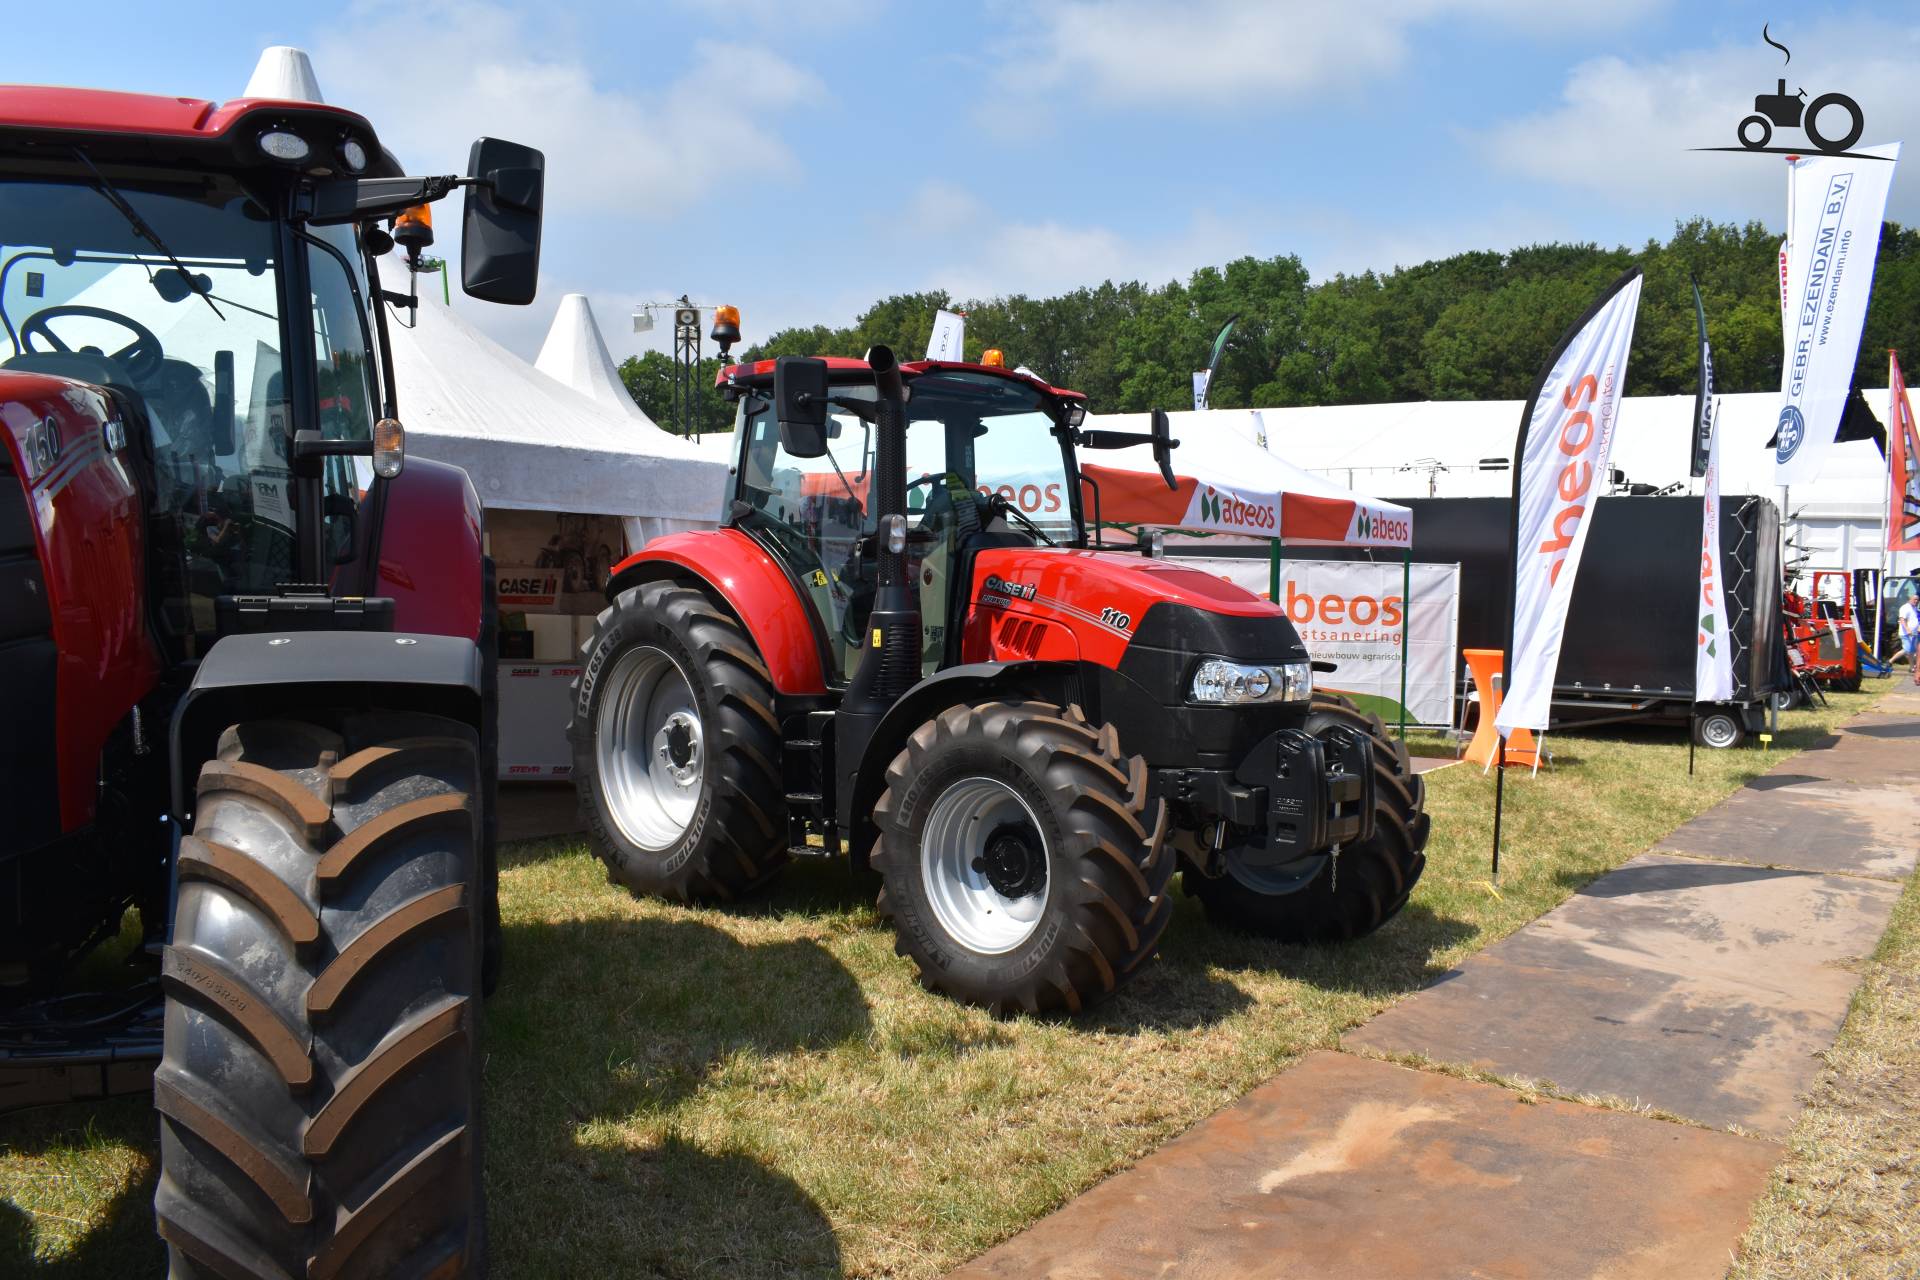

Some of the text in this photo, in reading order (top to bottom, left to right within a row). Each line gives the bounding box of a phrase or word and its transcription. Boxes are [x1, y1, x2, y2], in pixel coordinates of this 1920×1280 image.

[1791, 179, 1848, 397] GEBR. EZENDAM B.V.
[1819, 230, 1852, 345] www.ezendam.info
[1222, 492, 1275, 529] abeos
[1371, 511, 1408, 541] abeos
[498, 579, 541, 595] CASE
[986, 576, 1021, 596] CASE
[1101, 607, 1131, 630] 110
[1258, 580, 1402, 626] beos
[1301, 629, 1401, 645] stsanering
[580, 655, 603, 715] 540/65
[608, 628, 623, 647] 38
[1309, 651, 1401, 662] nieuwbouw agrarisch
[666, 799, 710, 873] MULTIBIB
